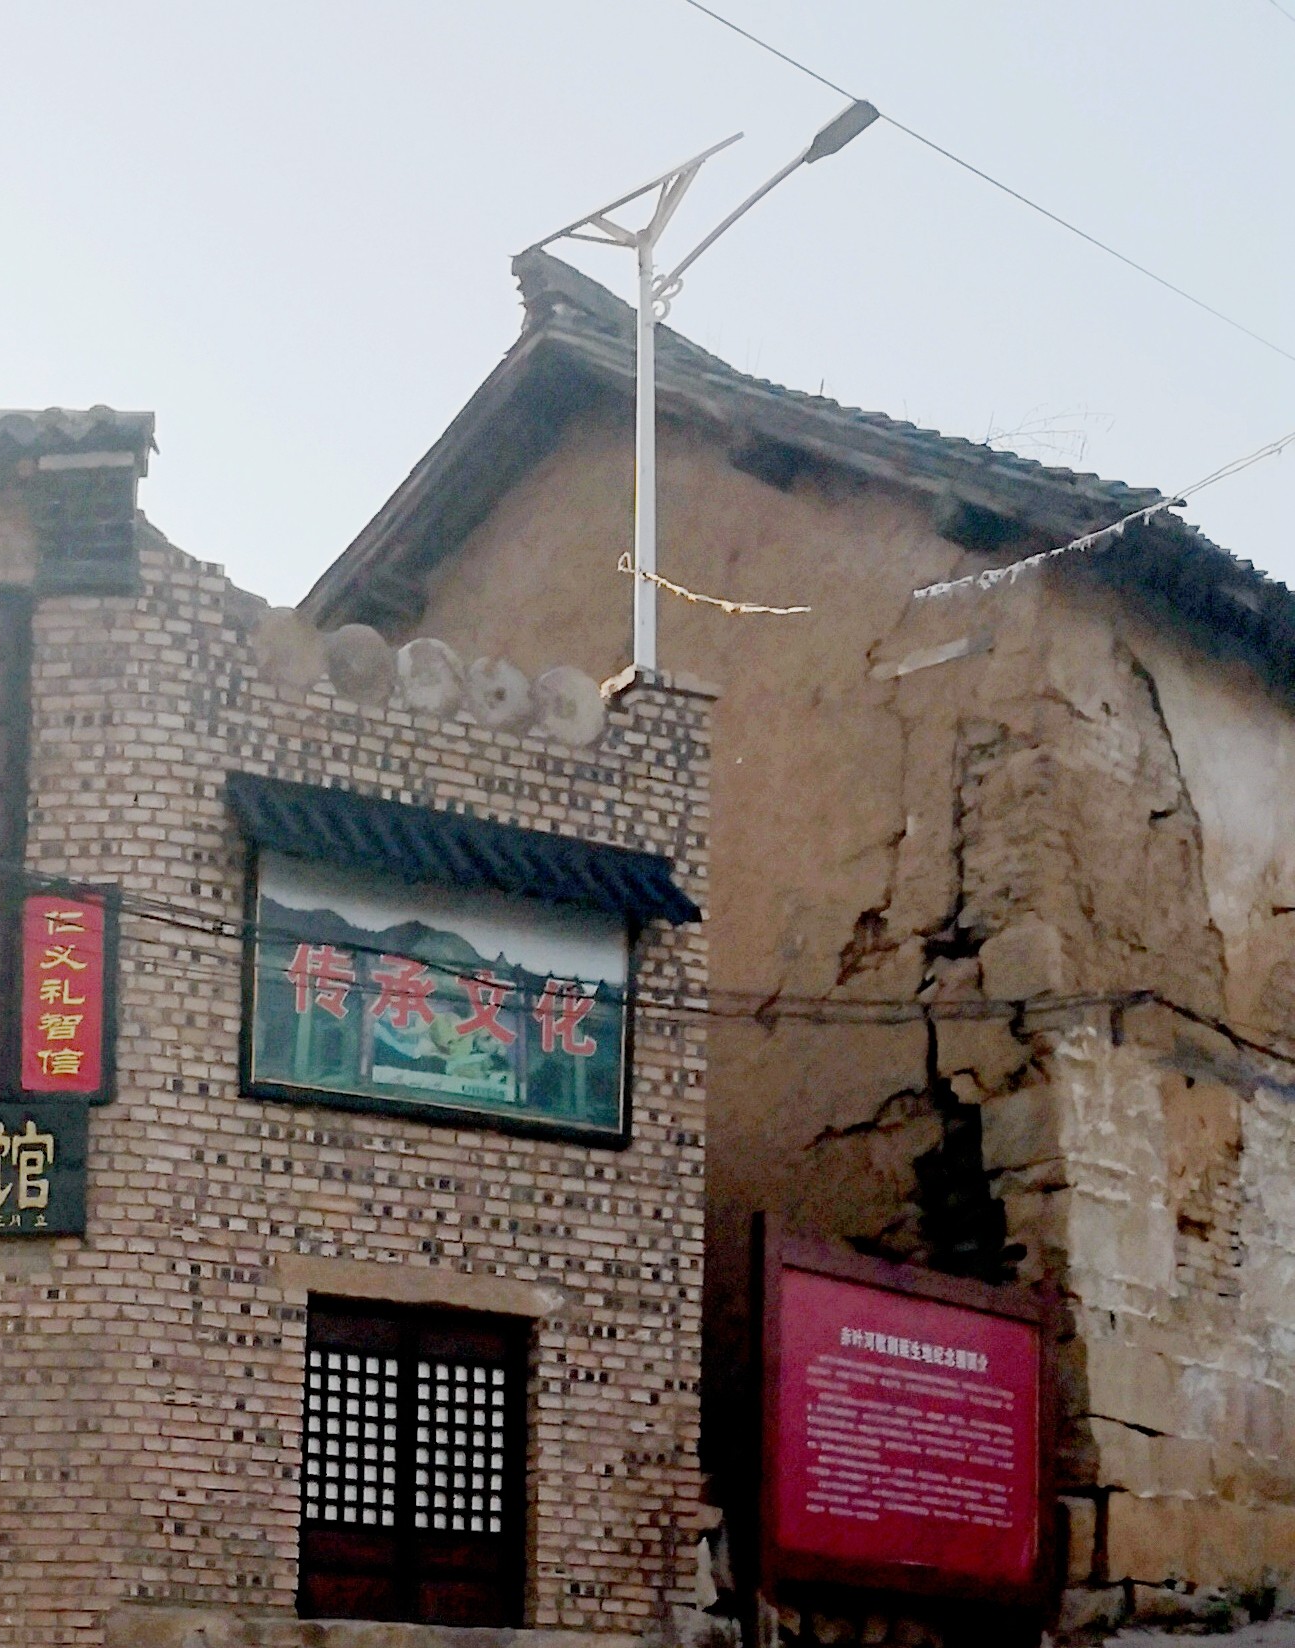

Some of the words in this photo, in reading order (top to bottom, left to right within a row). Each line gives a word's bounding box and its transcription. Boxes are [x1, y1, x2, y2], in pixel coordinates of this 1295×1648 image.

[37, 910, 88, 1077] 仁义礼智信
[288, 943, 597, 1056] 传承文化
